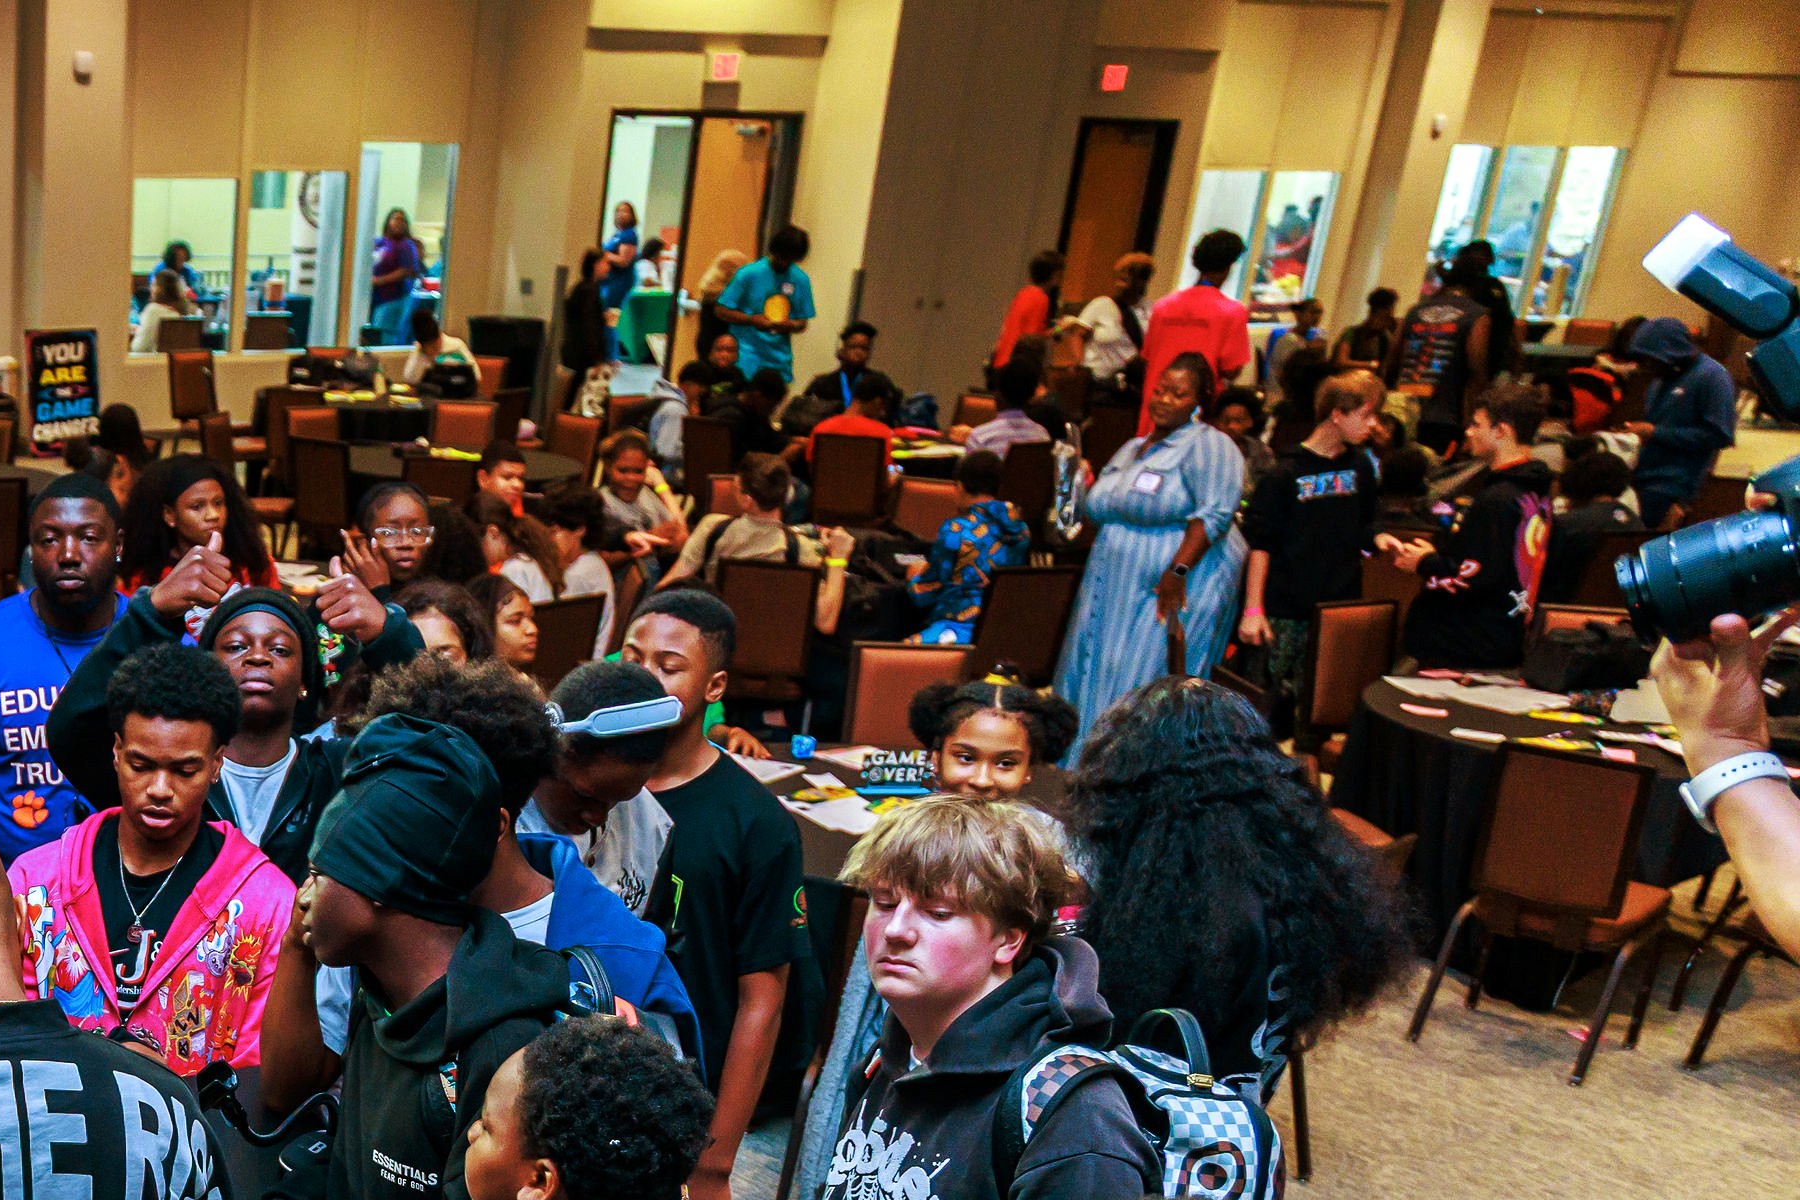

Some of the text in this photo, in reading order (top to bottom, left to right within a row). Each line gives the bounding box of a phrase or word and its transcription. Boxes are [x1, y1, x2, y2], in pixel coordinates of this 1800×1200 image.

[42, 341, 85, 365] YOU
[40, 365, 86, 386] ARE
[36, 398, 93, 422] GAME
[0, 685, 64, 716] EDU
[871, 750, 927, 766] GAME
[372, 1149, 438, 1186] ESSENTIALS
[380, 1168, 424, 1192] FEAR OF GOD
